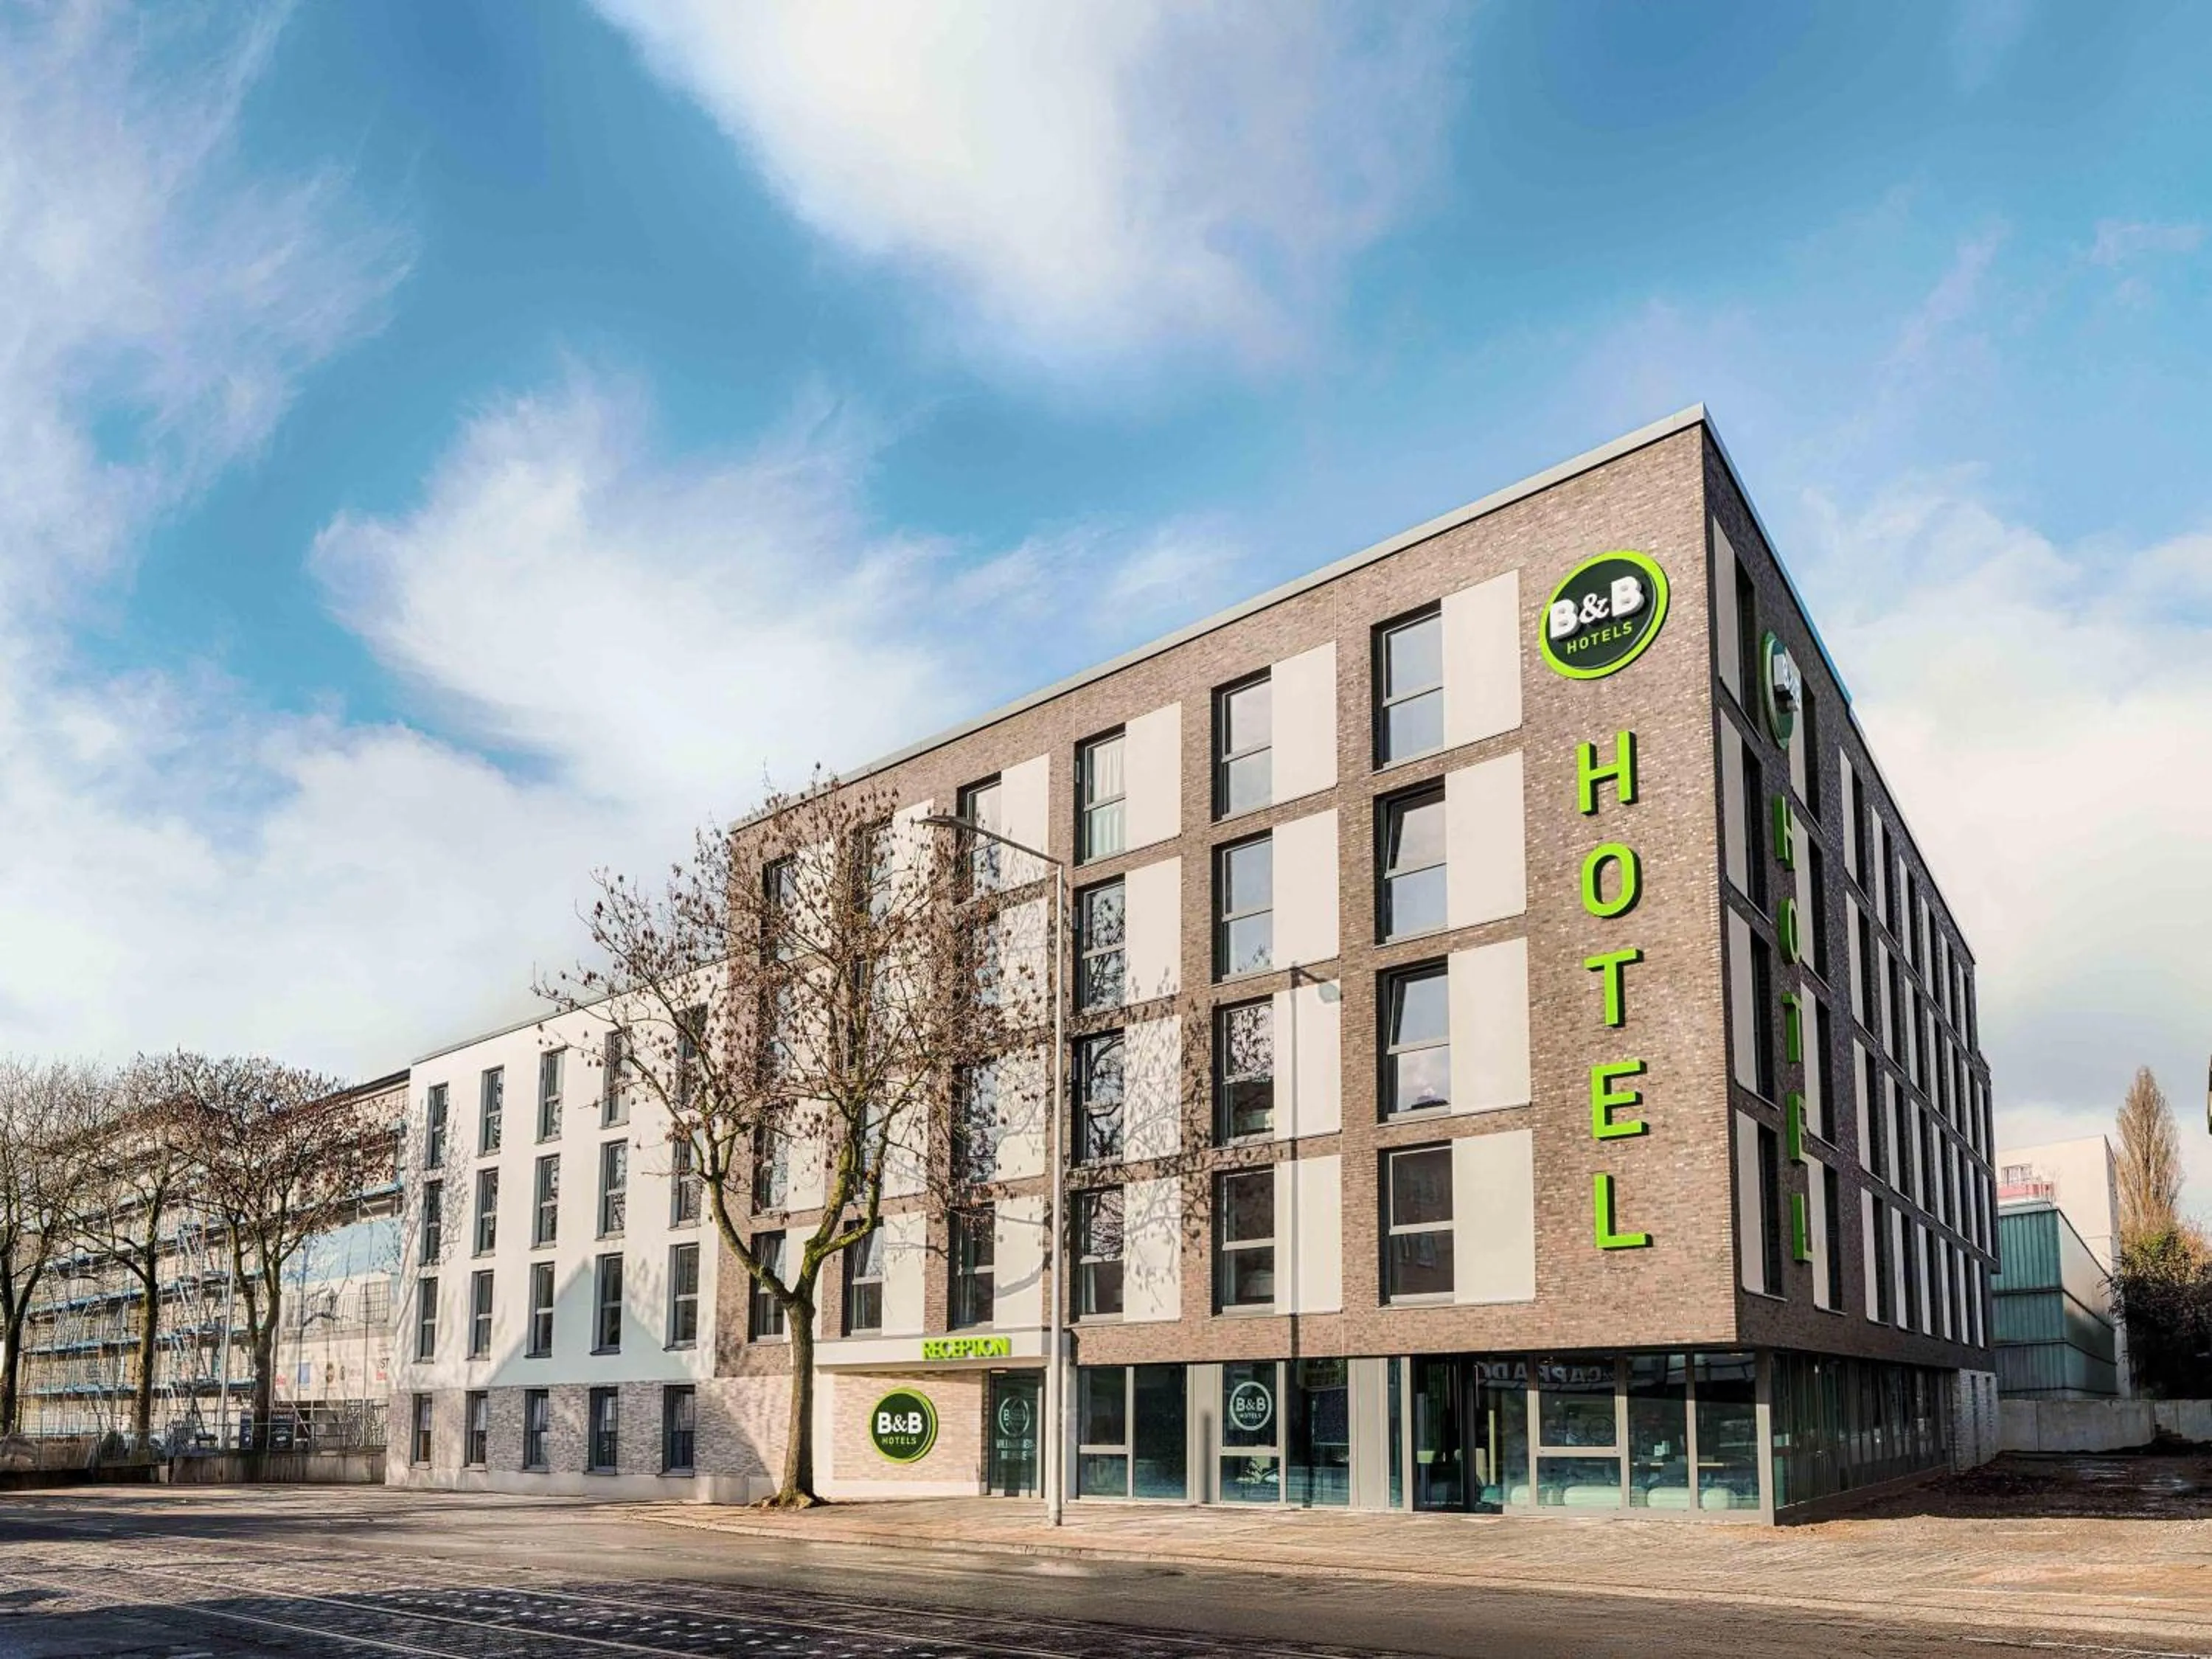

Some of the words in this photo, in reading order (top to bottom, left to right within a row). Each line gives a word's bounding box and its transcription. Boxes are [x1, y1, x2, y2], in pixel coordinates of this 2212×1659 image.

[1550, 576, 1644, 639] B&B
[1567, 622, 1632, 654] HOTELS
[1576, 730, 1649, 1249] HOTEL
[922, 1337, 1009, 1360] RECEPTION
[1236, 1397, 1266, 1411] B&B
[877, 1412, 922, 1433] B&B
[882, 1436, 917, 1444] HOTELS
